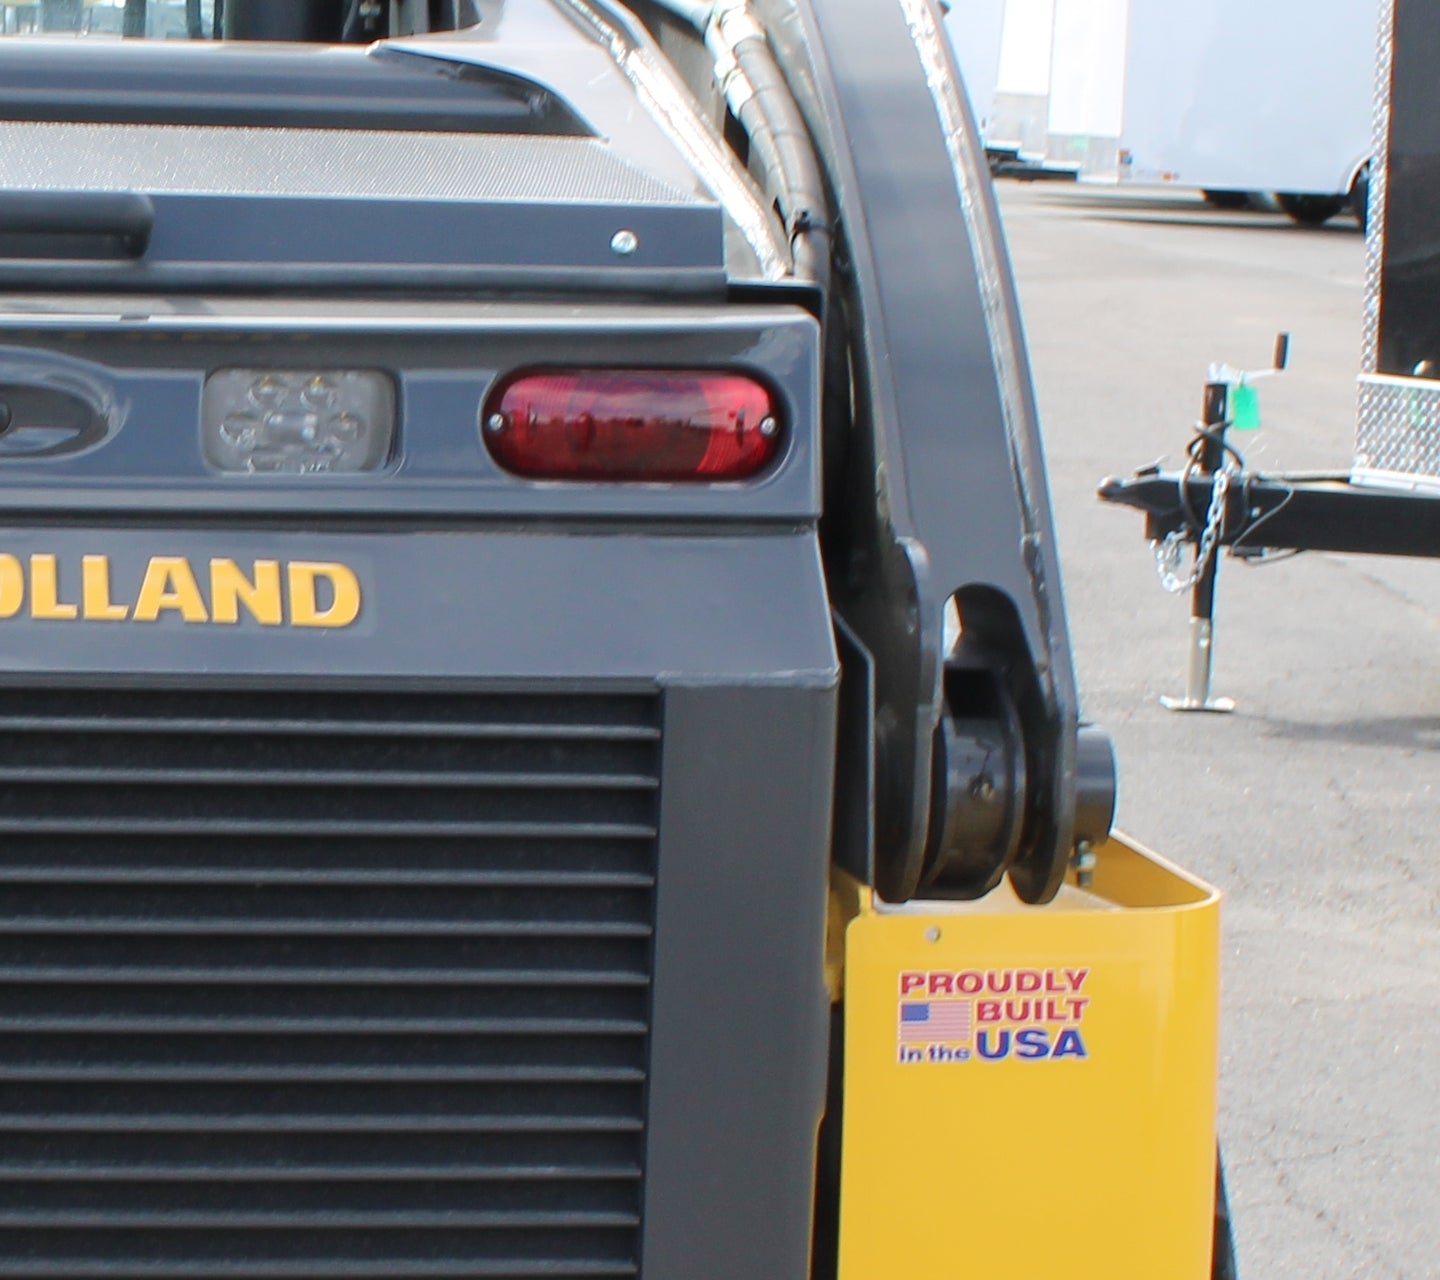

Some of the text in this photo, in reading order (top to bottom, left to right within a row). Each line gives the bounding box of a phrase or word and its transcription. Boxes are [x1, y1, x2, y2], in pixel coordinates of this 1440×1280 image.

[900, 970, 1088, 995] PROUDLY
[976, 999, 1088, 1022] BUILT
[929, 1045, 970, 1061] the
[976, 1029, 1087, 1060] USA
